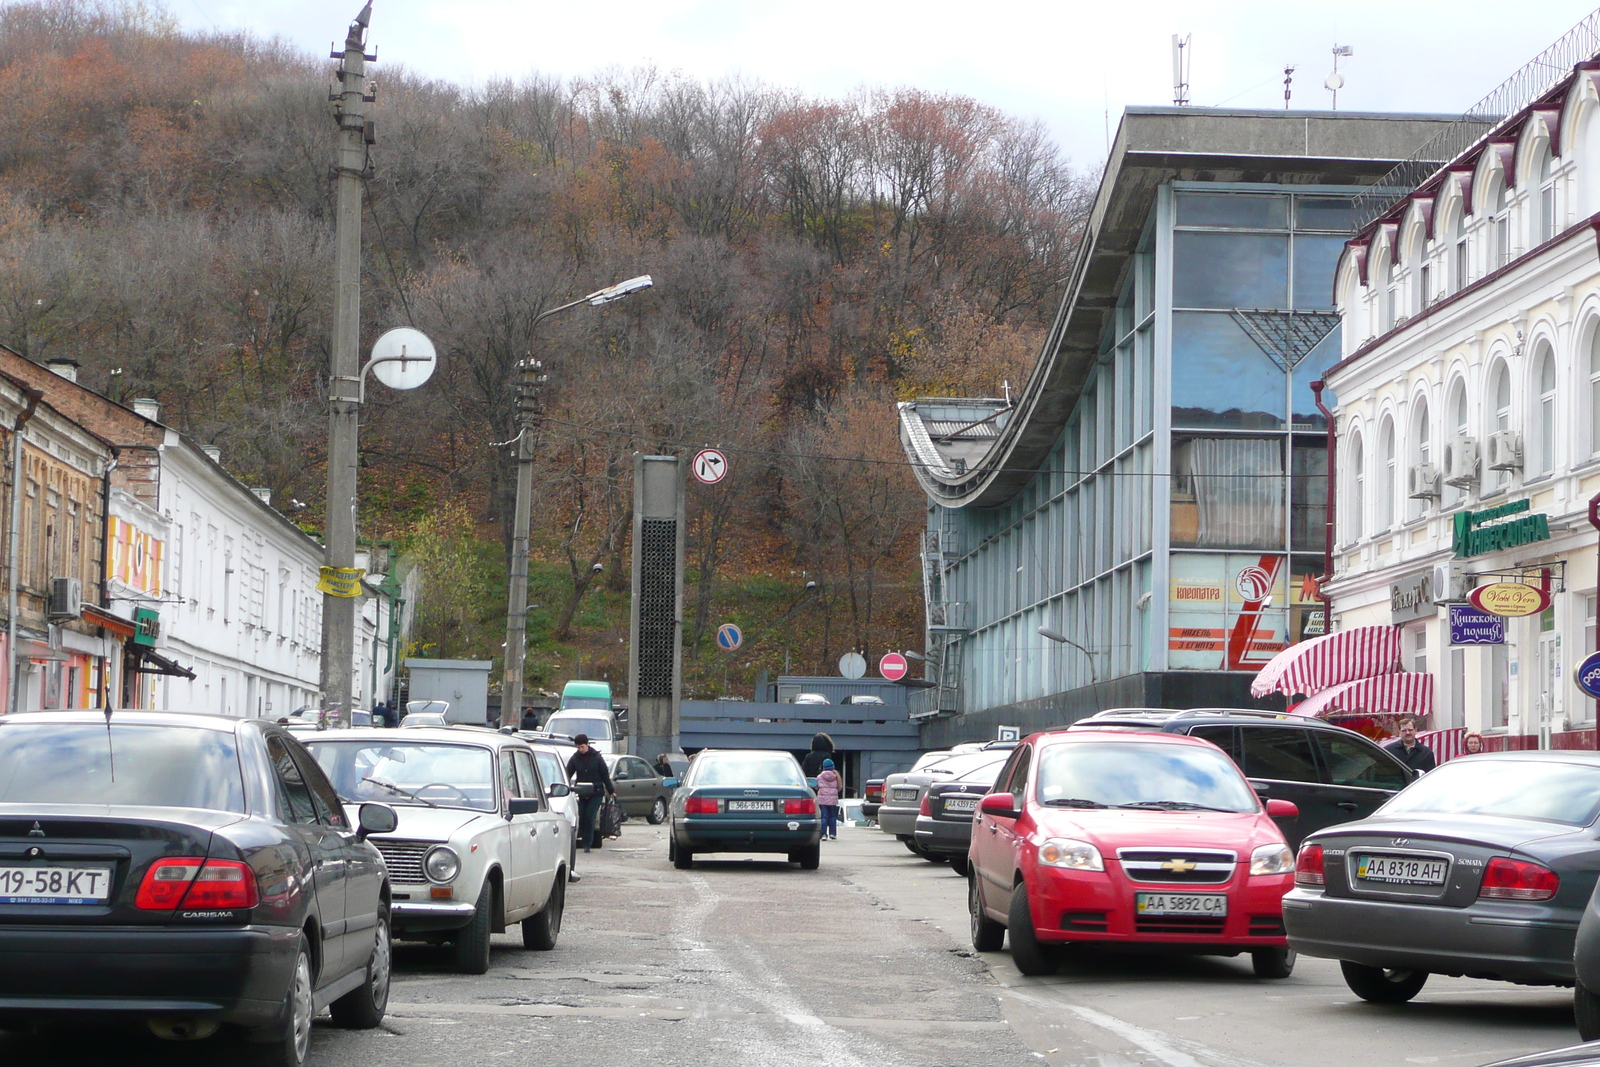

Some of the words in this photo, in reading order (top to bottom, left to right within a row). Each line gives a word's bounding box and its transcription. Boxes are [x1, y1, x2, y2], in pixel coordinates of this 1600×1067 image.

[1468, 513, 1550, 557] УНІВЕРСАЛЬНА
[1451, 608, 1501, 627] Книжкова
[1252, 642, 1283, 651] ТОВАРИ
[1003, 731, 1015, 741] P
[1367, 859, 1385, 875] AA
[1388, 861, 1419, 877] 8318
[1421, 866, 1442, 879] AH
[1457, 858, 1483, 867] SONATA
[1147, 896, 1165, 909] AA
[1169, 897, 1199, 910] 5892
[1203, 898, 1222, 911] CA
